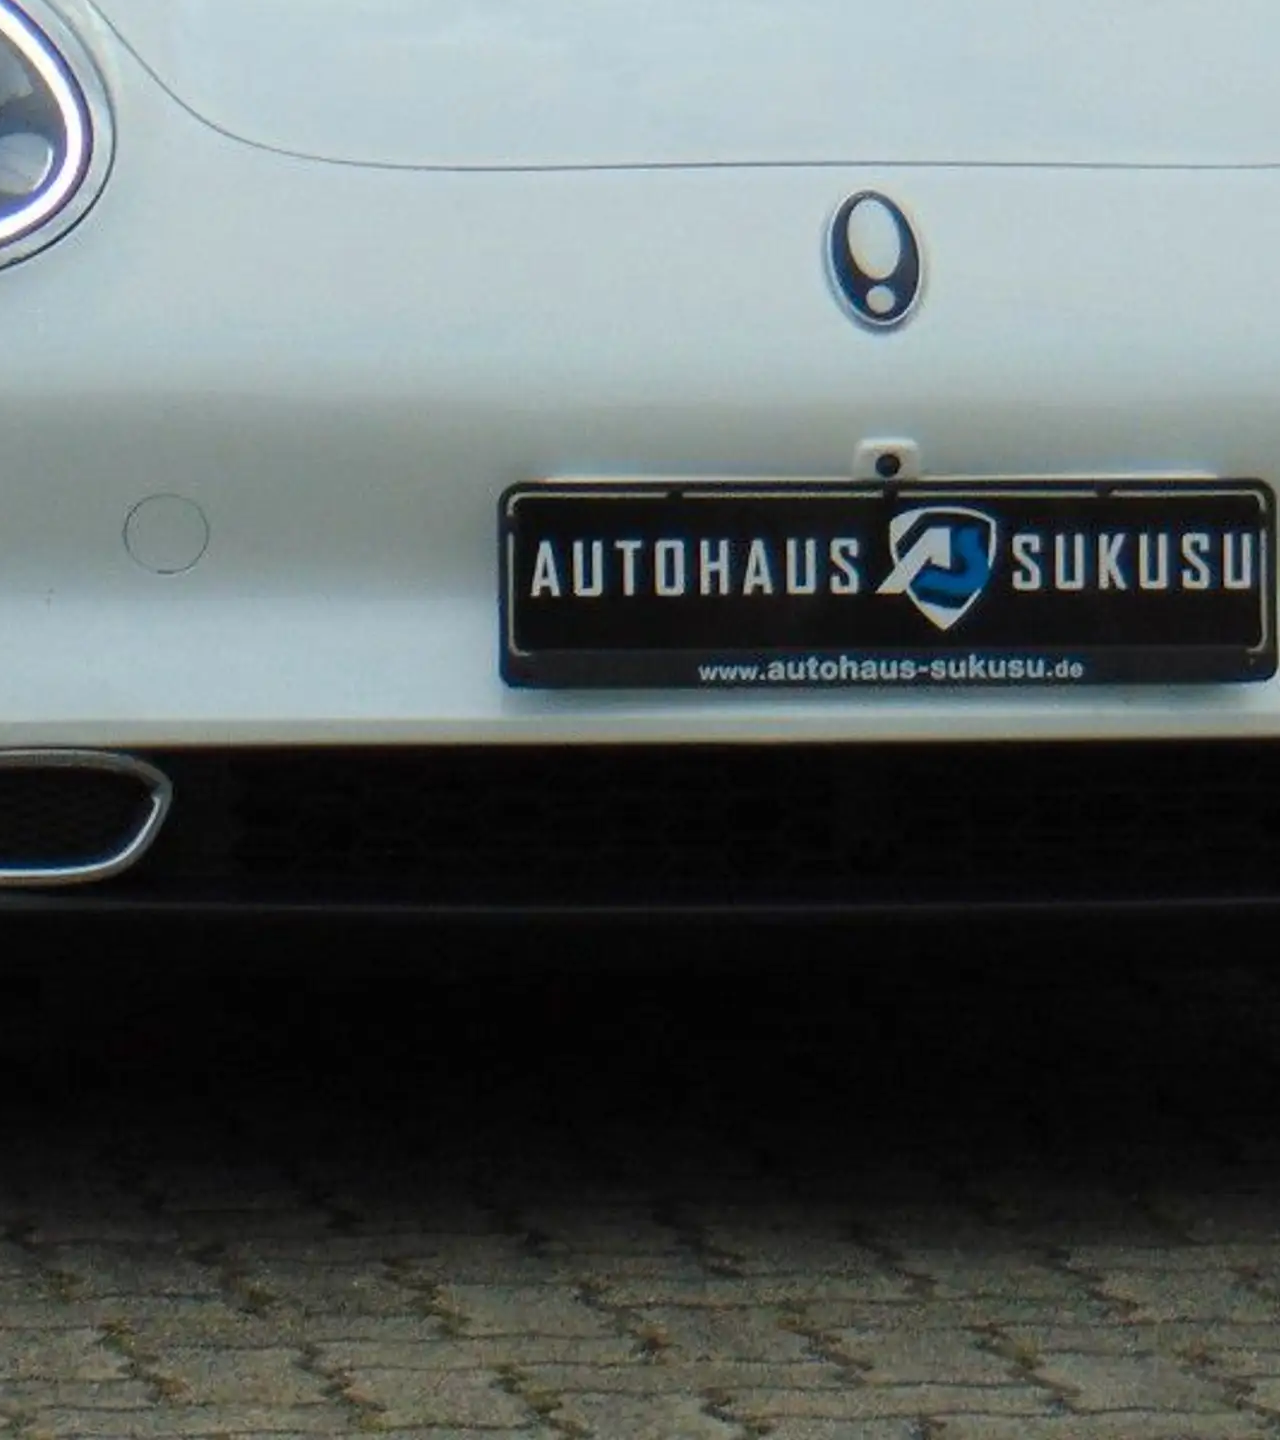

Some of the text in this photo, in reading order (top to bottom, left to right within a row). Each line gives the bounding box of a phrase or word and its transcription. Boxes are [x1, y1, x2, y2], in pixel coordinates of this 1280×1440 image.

[530, 533, 1253, 598] AUTOHAUS SUKUSU
[698, 652, 1084, 681] www.autohaus-sukusu.de
